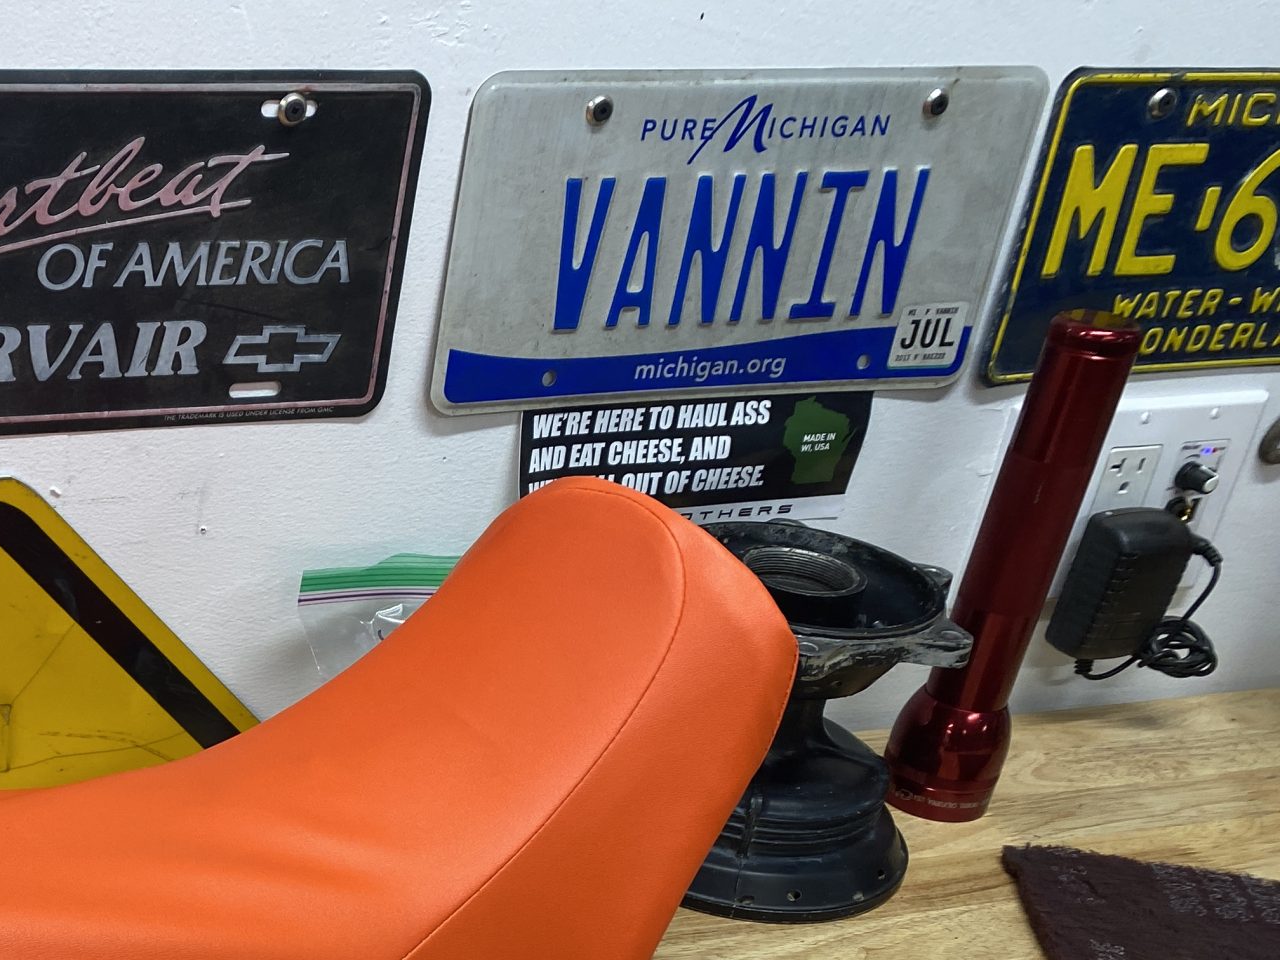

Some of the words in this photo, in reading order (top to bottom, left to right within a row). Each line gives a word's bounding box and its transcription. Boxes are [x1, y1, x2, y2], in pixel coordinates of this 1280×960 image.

[1187, 92, 1280, 127] MIC
[640, 119, 714, 142] PURE
[687, 94, 890, 165] MICHIGAN
[37, 242, 115, 291] OF
[113, 239, 351, 287] AMERICA
[553, 169, 929, 329] VANNIN
[900, 317, 954, 349] JUL
[1139, 321, 1280, 356] ONDERL
[634, 355, 785, 382] michigan.org
[533, 410, 592, 439] WE'RE
[593, 408, 646, 433] HERE
[649, 405, 674, 430] TO
[676, 402, 727, 429] HAUL
[730, 400, 772, 426] ASS
[803, 433, 826, 442] MADE
[827, 432, 836, 441] IN
[528, 445, 567, 474] AND
[568, 442, 606, 468] EAT
[607, 437, 685, 466] CHEESE,
[688, 435, 731, 461] AND
[814, 442, 830, 451] USA
[664, 470, 691, 494] OF
[691, 465, 765, 492] CHEESE.
